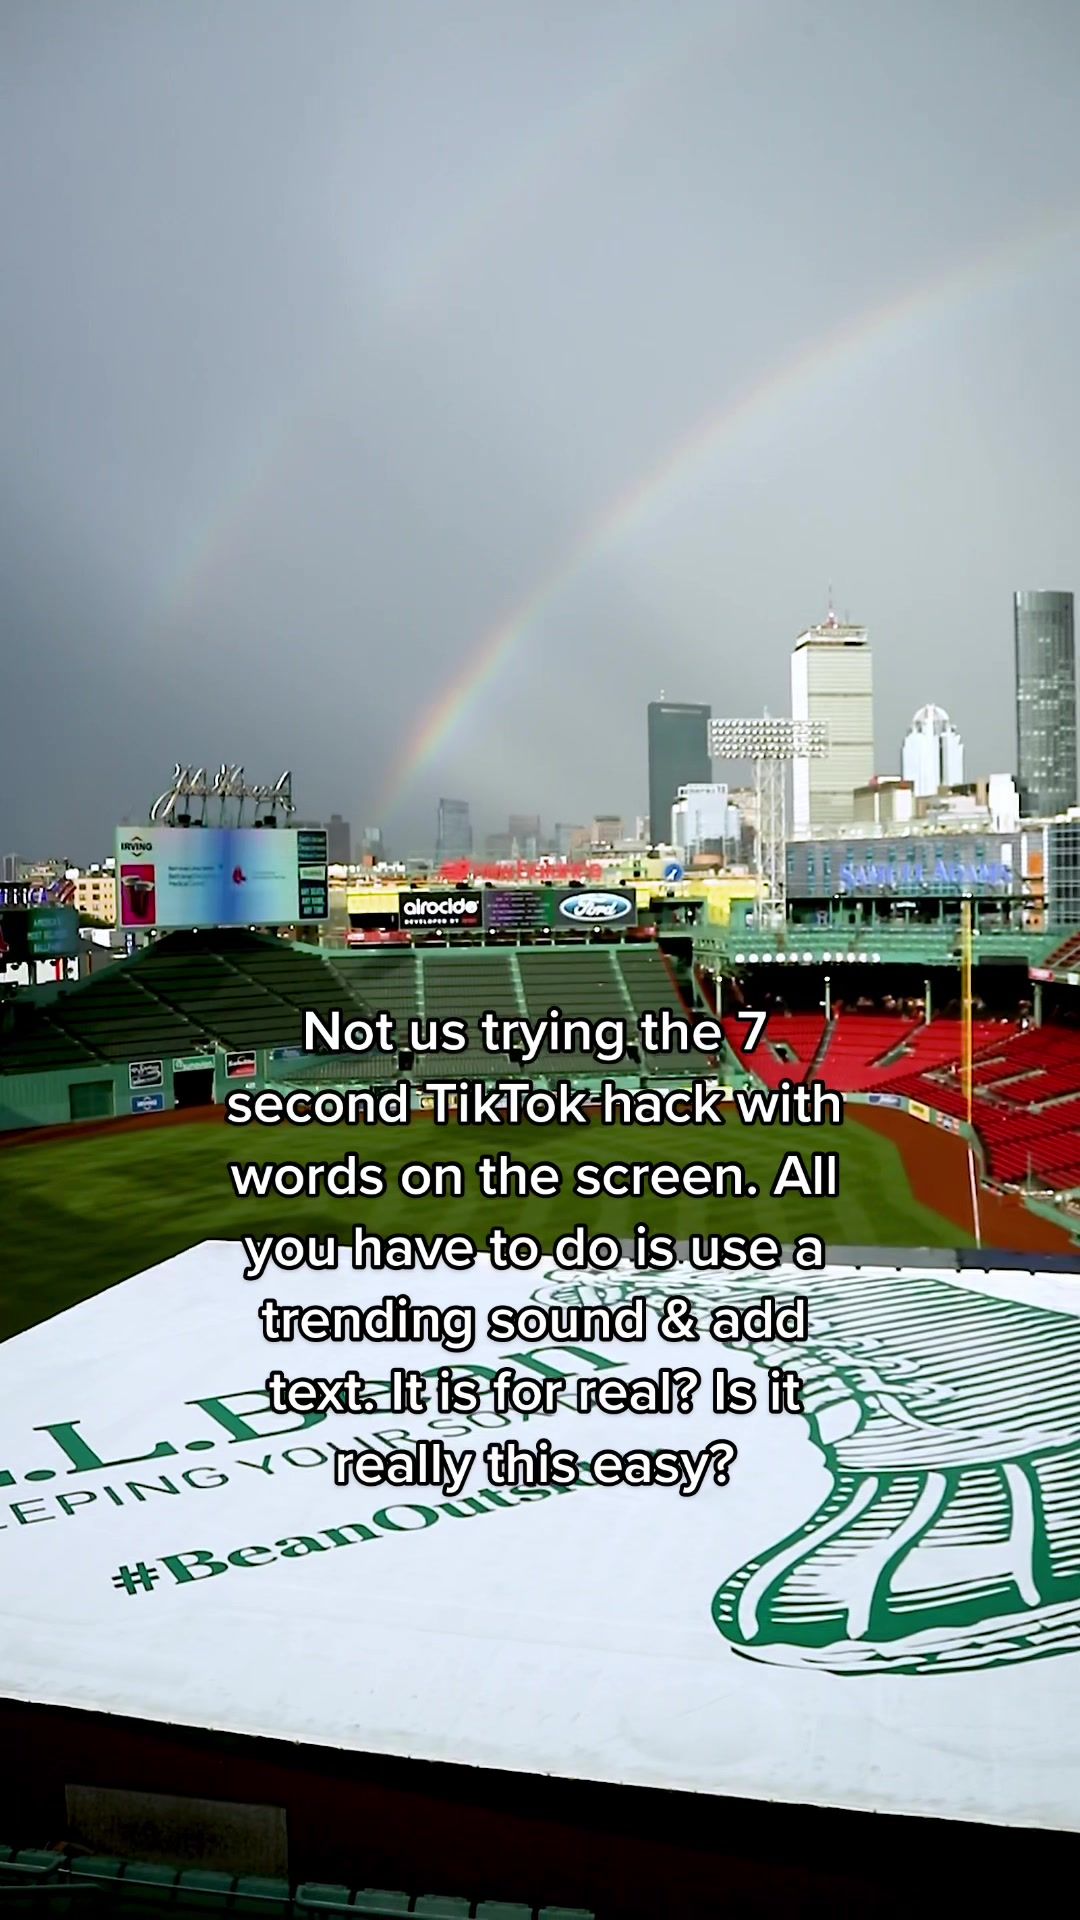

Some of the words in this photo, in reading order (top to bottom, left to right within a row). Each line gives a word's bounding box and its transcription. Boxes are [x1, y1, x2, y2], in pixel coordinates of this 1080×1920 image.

[121, 841, 152, 852] IRVING
[573, 894, 618, 916] Ford
[0, 1467, 229, 1529] EPING
